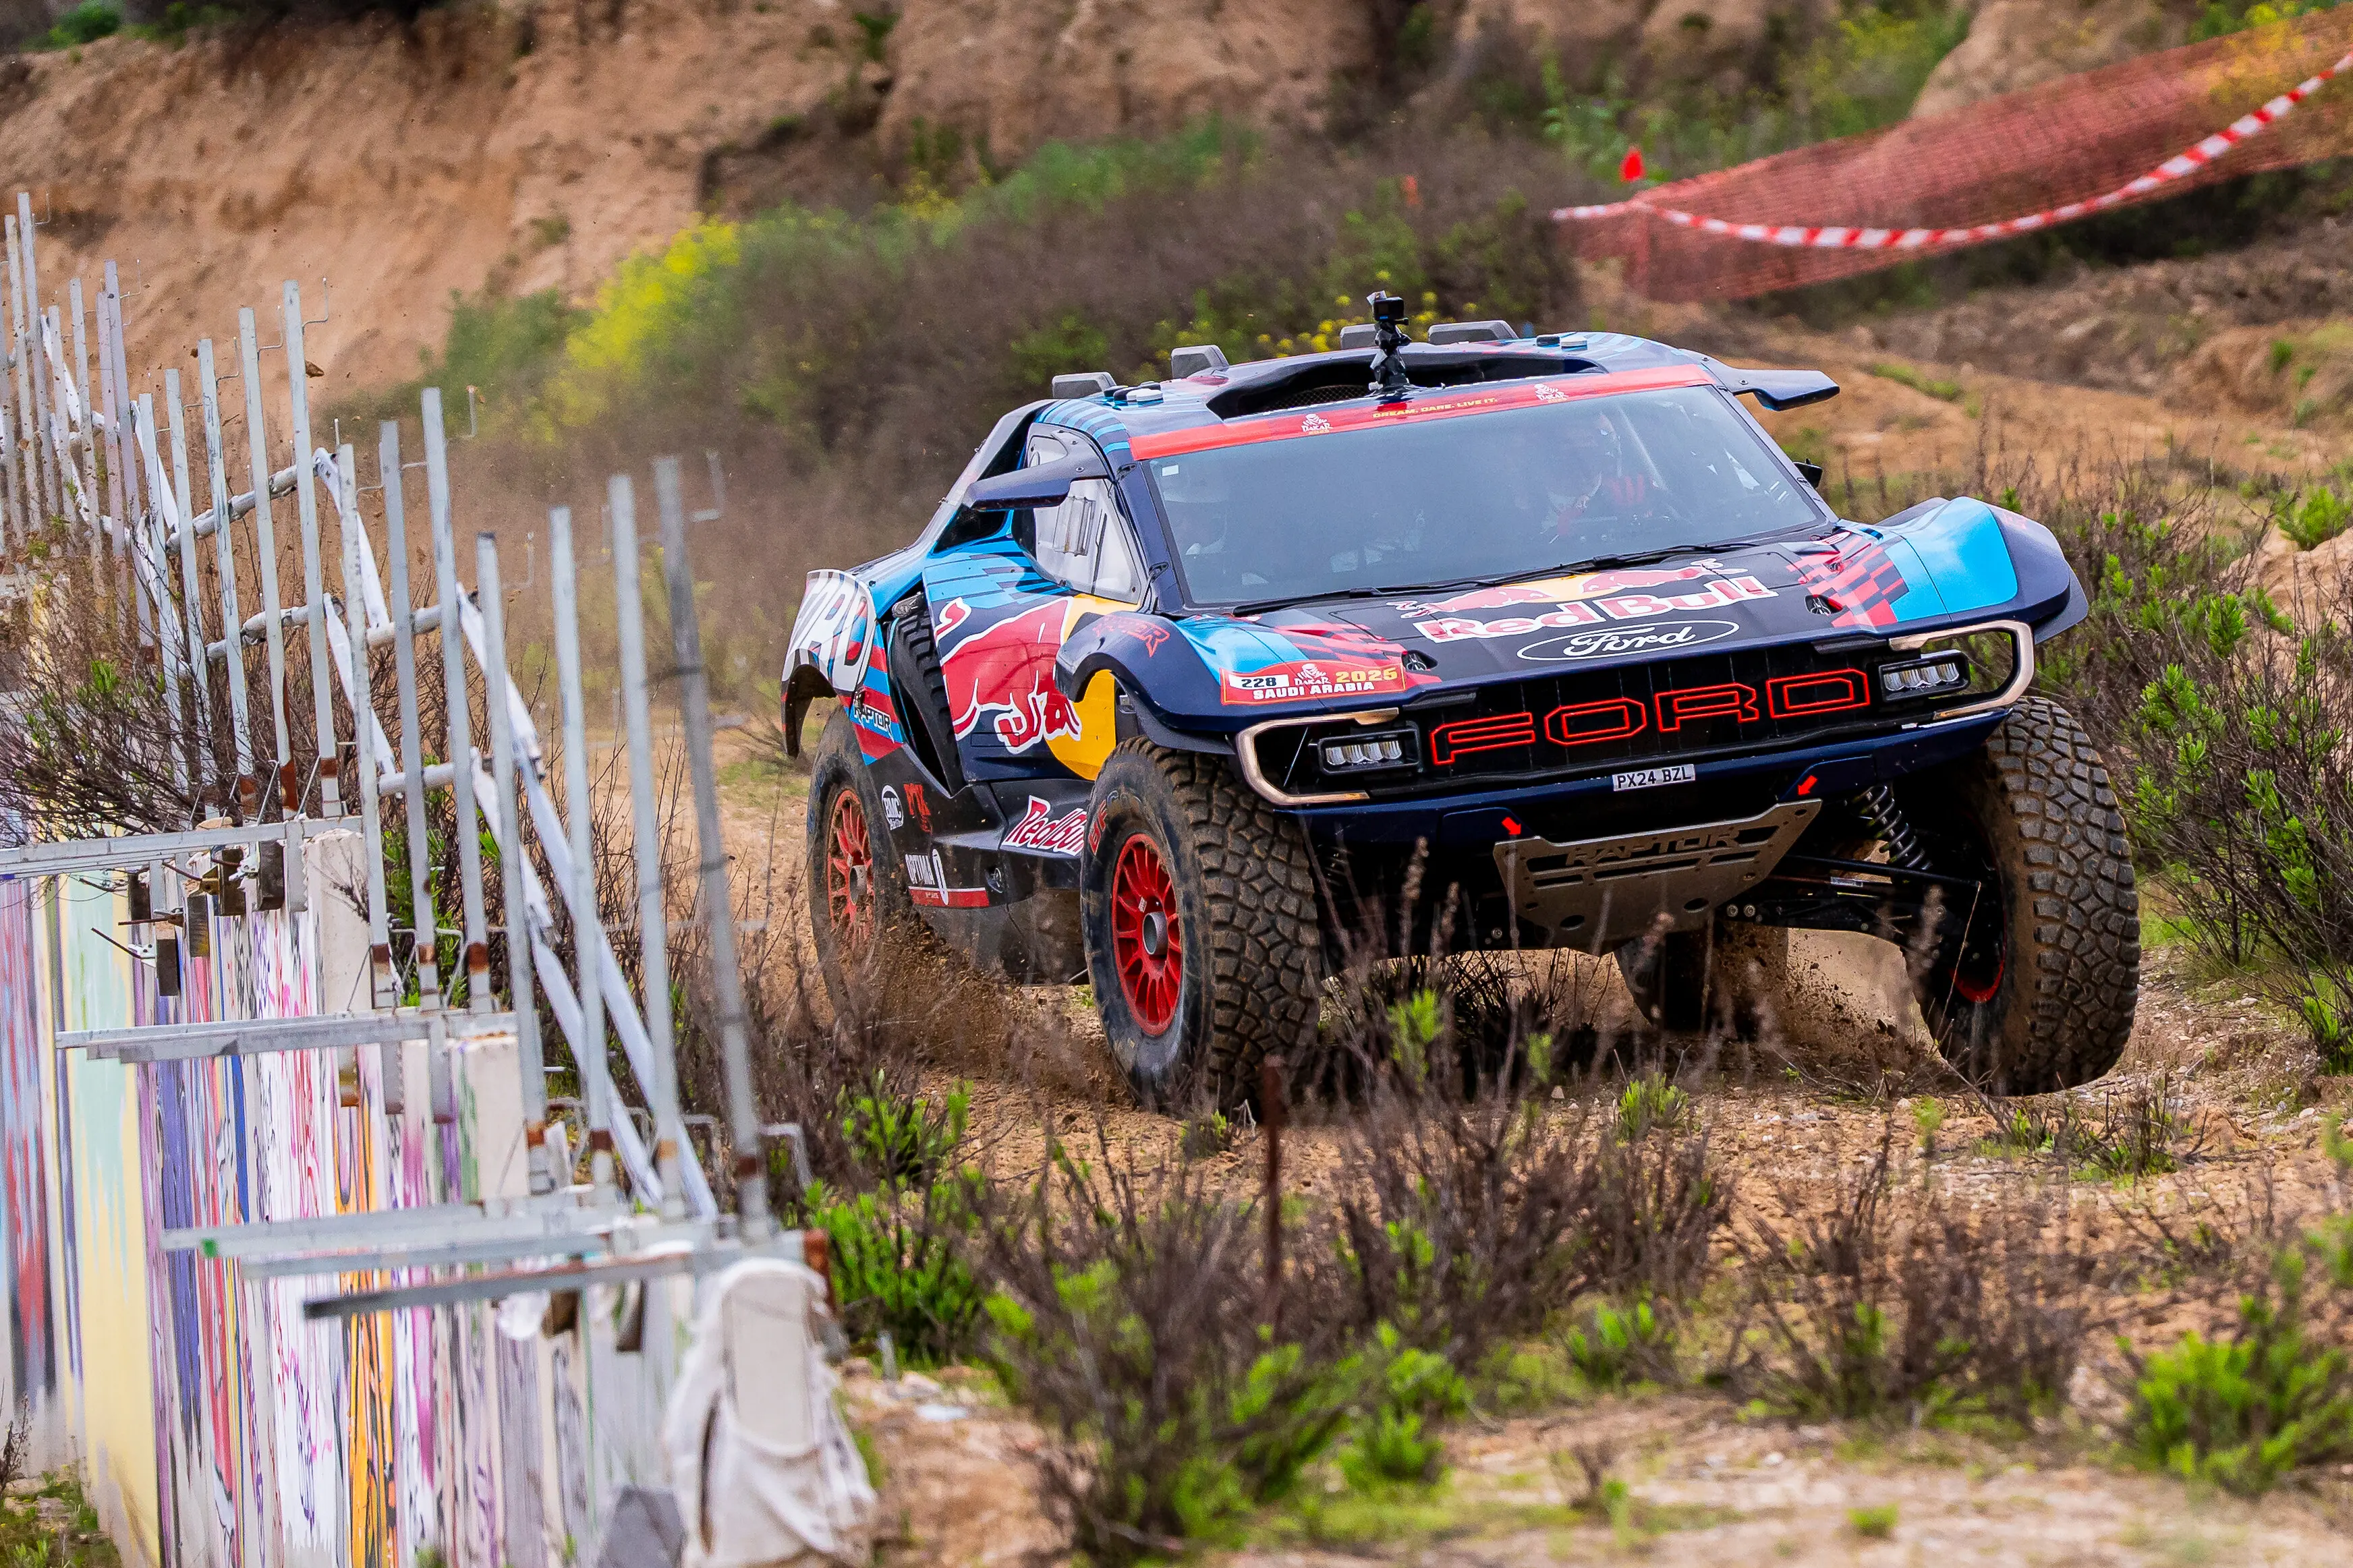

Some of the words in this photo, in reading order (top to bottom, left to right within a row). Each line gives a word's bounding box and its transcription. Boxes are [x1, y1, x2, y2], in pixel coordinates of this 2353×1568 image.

[1457, 399, 1481, 407] LIVE
[1412, 602, 1607, 643] Red
[1593, 575, 1780, 620] Bull
[1563, 626, 1696, 658] Ford
[1241, 677, 1277, 688] 228
[1335, 667, 1398, 683] 2025
[1253, 686, 1305, 700] SAUDI
[1309, 681, 1375, 695] ARABIA
[1431, 668, 1871, 765] FORD
[1616, 771, 1657, 789] PX24
[1661, 766, 1692, 783] BZL
[1000, 795, 1083, 848] Red
